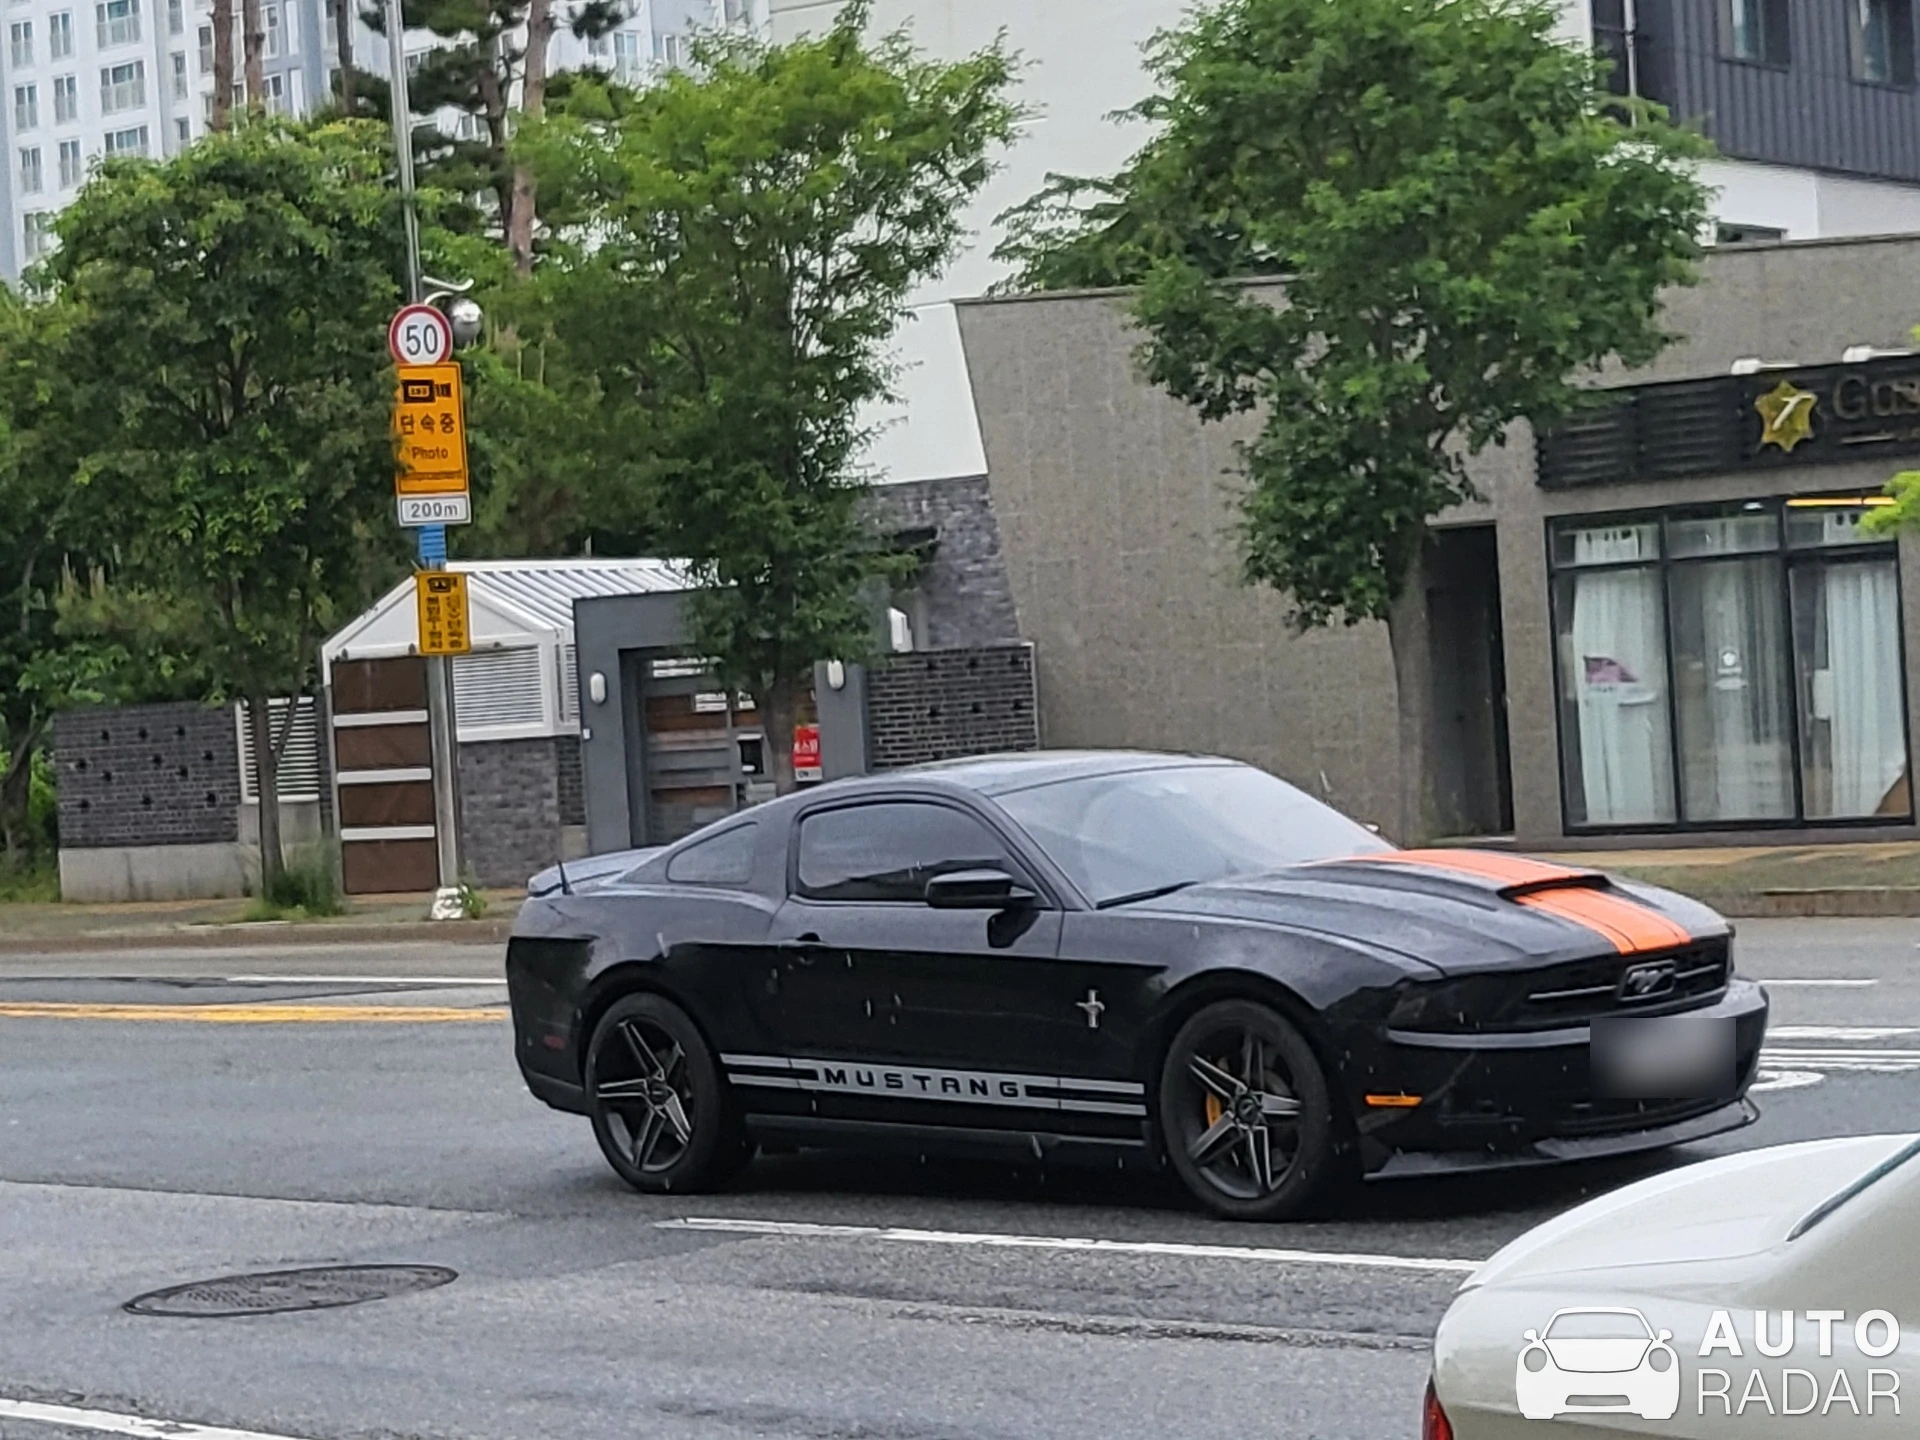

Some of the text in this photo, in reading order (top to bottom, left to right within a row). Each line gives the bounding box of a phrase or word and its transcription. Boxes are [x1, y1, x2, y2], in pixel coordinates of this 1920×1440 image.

[406, 323, 438, 356] 50
[400, 412, 455, 435] 단속중
[411, 446, 449, 459] Photo
[411, 502, 458, 518] 200m
[821, 1066, 1020, 1099] MUSTANG
